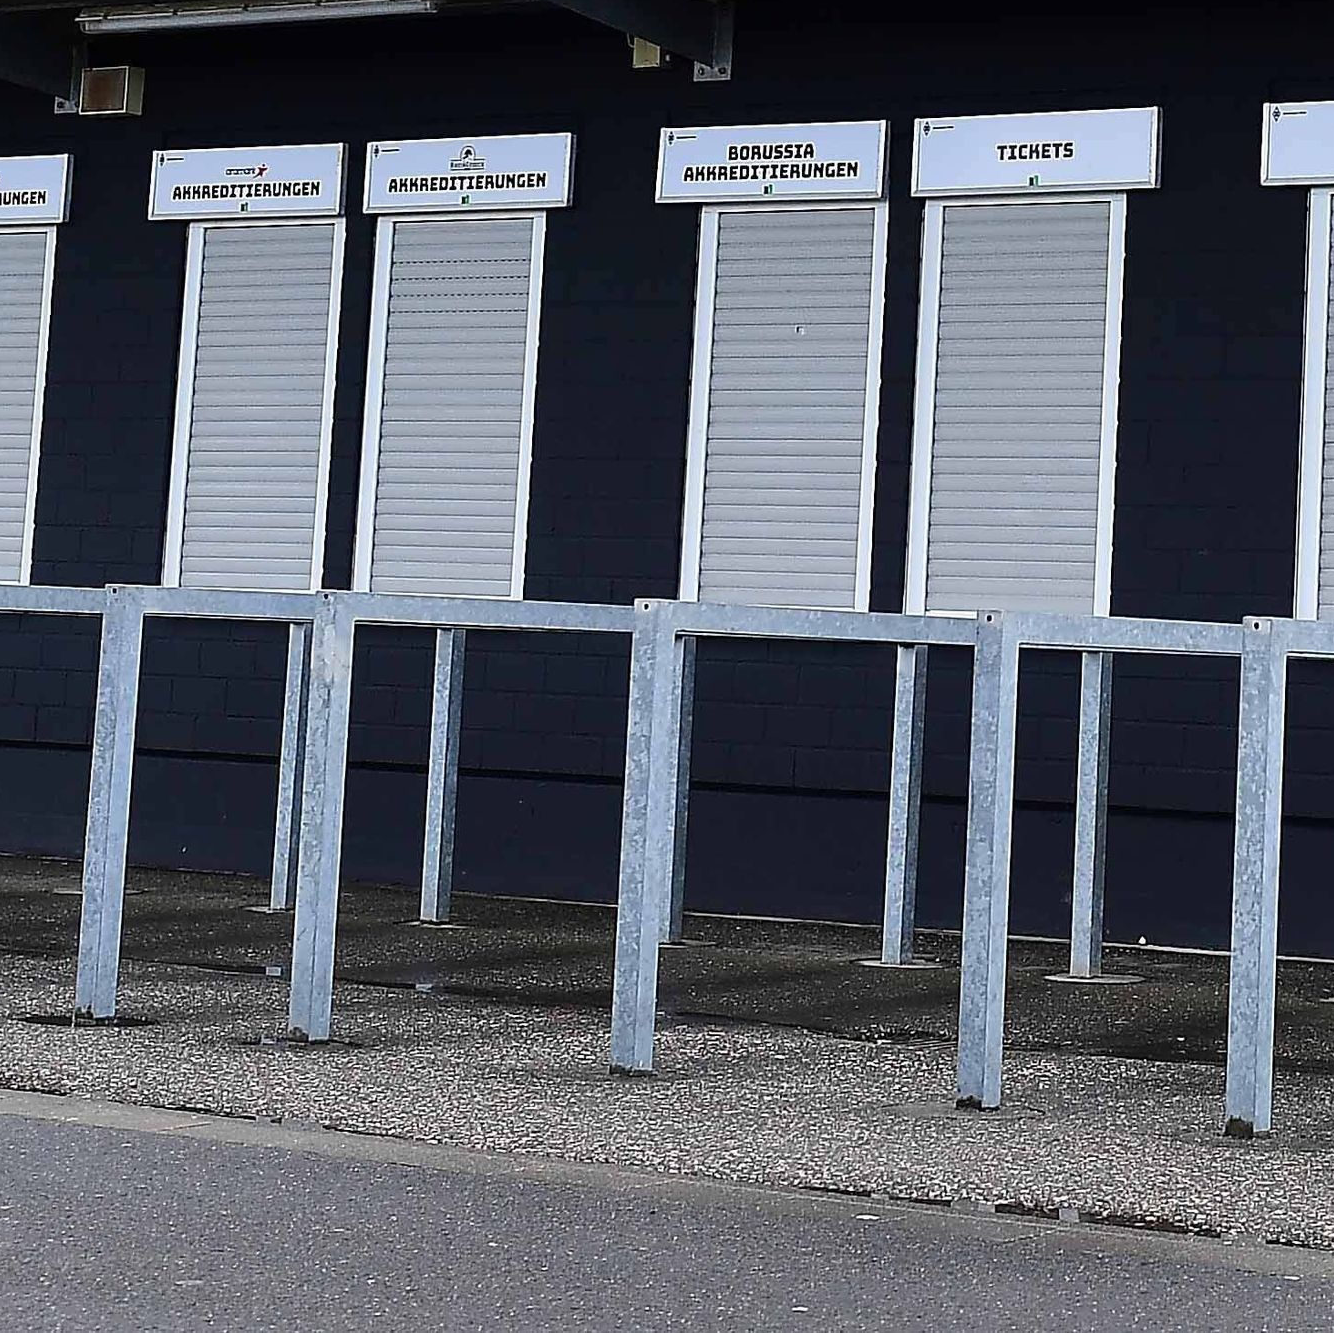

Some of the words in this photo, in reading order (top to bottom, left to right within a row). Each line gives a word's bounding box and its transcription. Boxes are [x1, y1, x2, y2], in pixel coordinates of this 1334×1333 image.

[727, 143, 815, 161] BORUSSIA
[996, 142, 1074, 161] TICKETS
[683, 162, 859, 182] AKKREDITIERUNGEN
[172, 181, 321, 201] AKKREDITIERUNGEN
[388, 172, 547, 193] AKKREDITIERUNGEN
